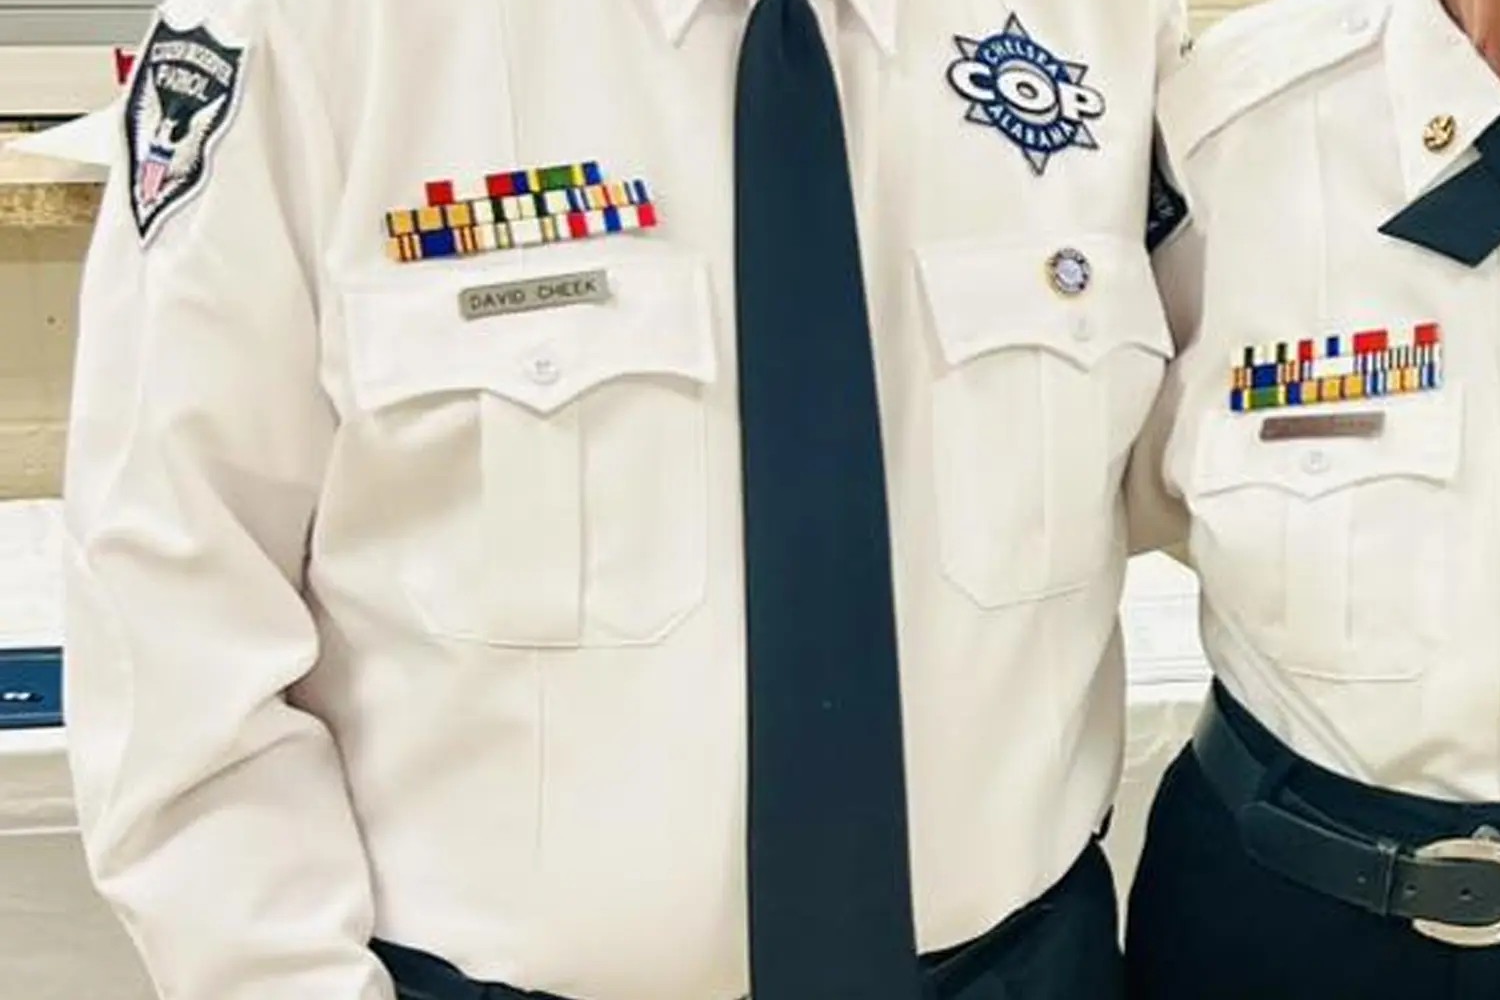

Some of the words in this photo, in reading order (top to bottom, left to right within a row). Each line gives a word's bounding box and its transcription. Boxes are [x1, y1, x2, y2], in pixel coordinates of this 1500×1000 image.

[983, 38, 1059, 74] CHELSEA
[947, 57, 1106, 121] COP
[988, 104, 1075, 147] ALABAMA
[469, 288, 526, 310] DAVID
